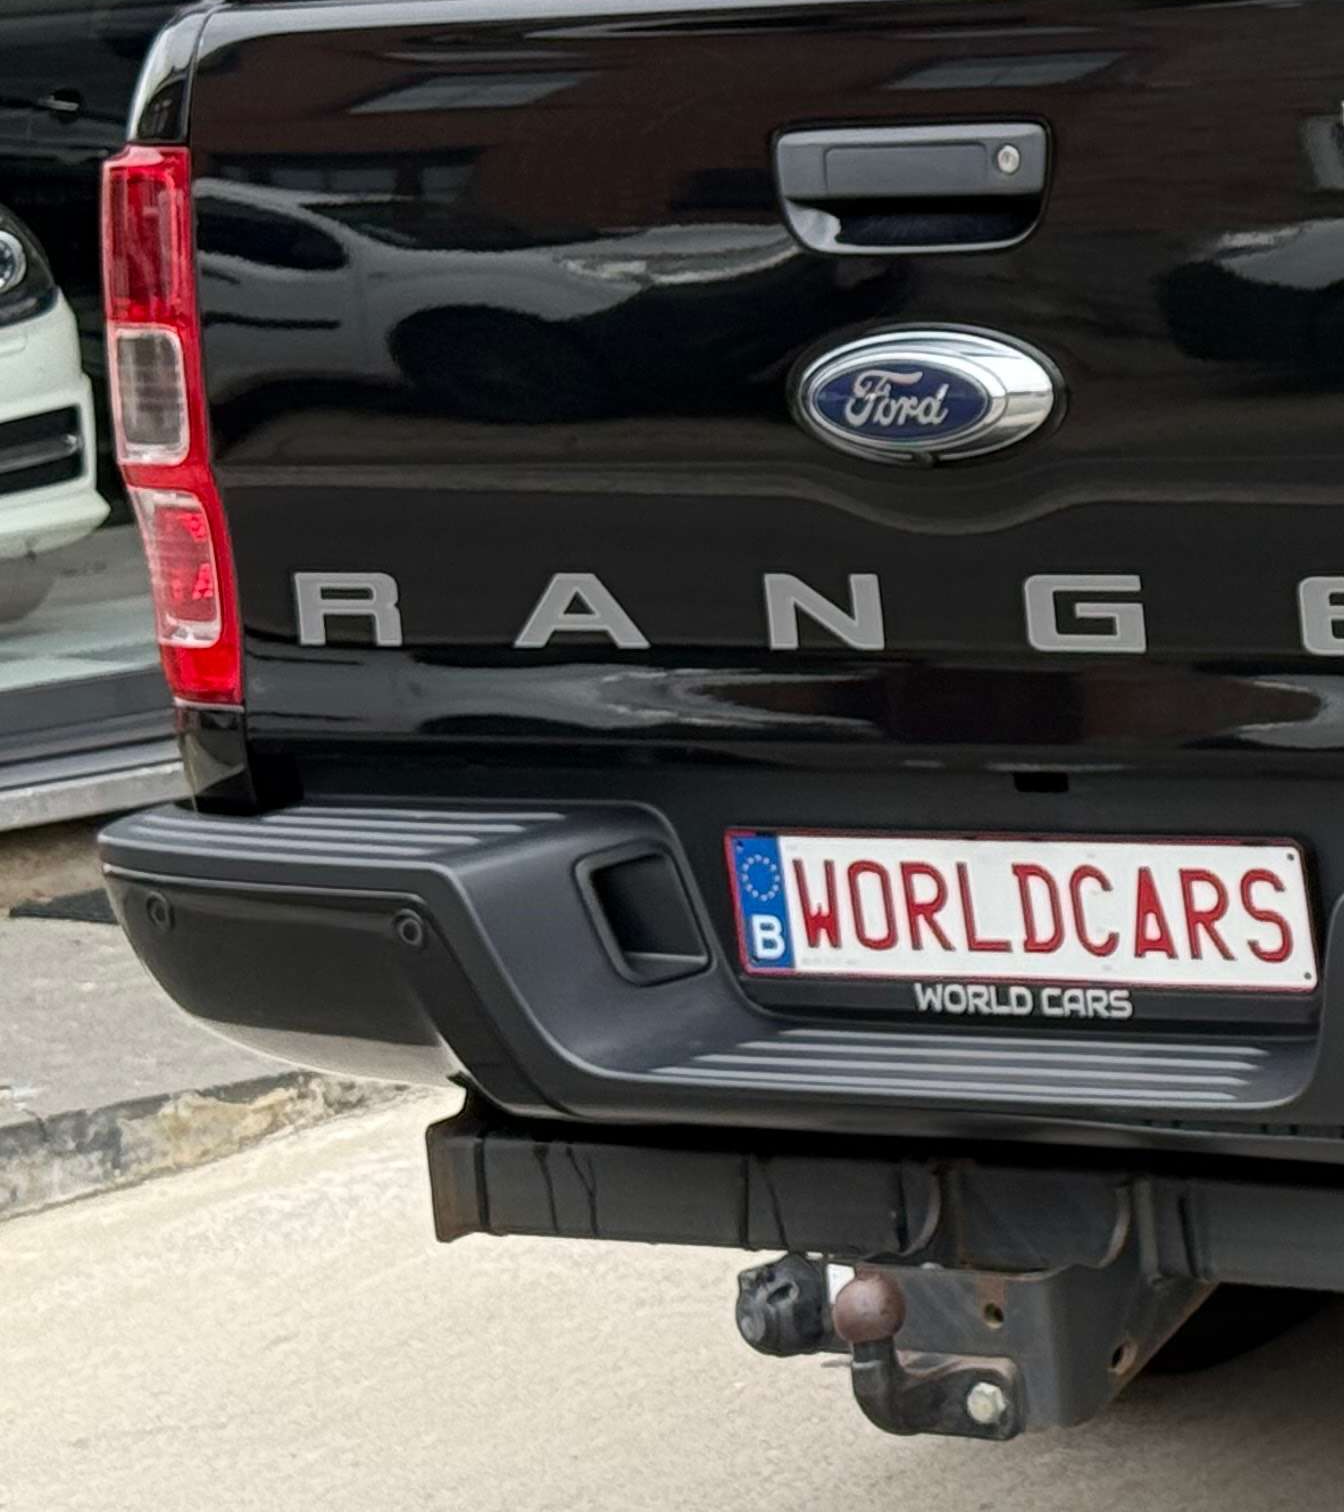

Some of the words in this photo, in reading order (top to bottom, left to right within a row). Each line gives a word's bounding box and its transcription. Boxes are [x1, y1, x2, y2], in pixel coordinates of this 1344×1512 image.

[845, 369, 950, 428] Ford
[792, 859, 1295, 964] WORLDCARS
[752, 915, 784, 961] B
[913, 982, 1033, 1016] WORLD
[1041, 988, 1133, 1019] CARS
